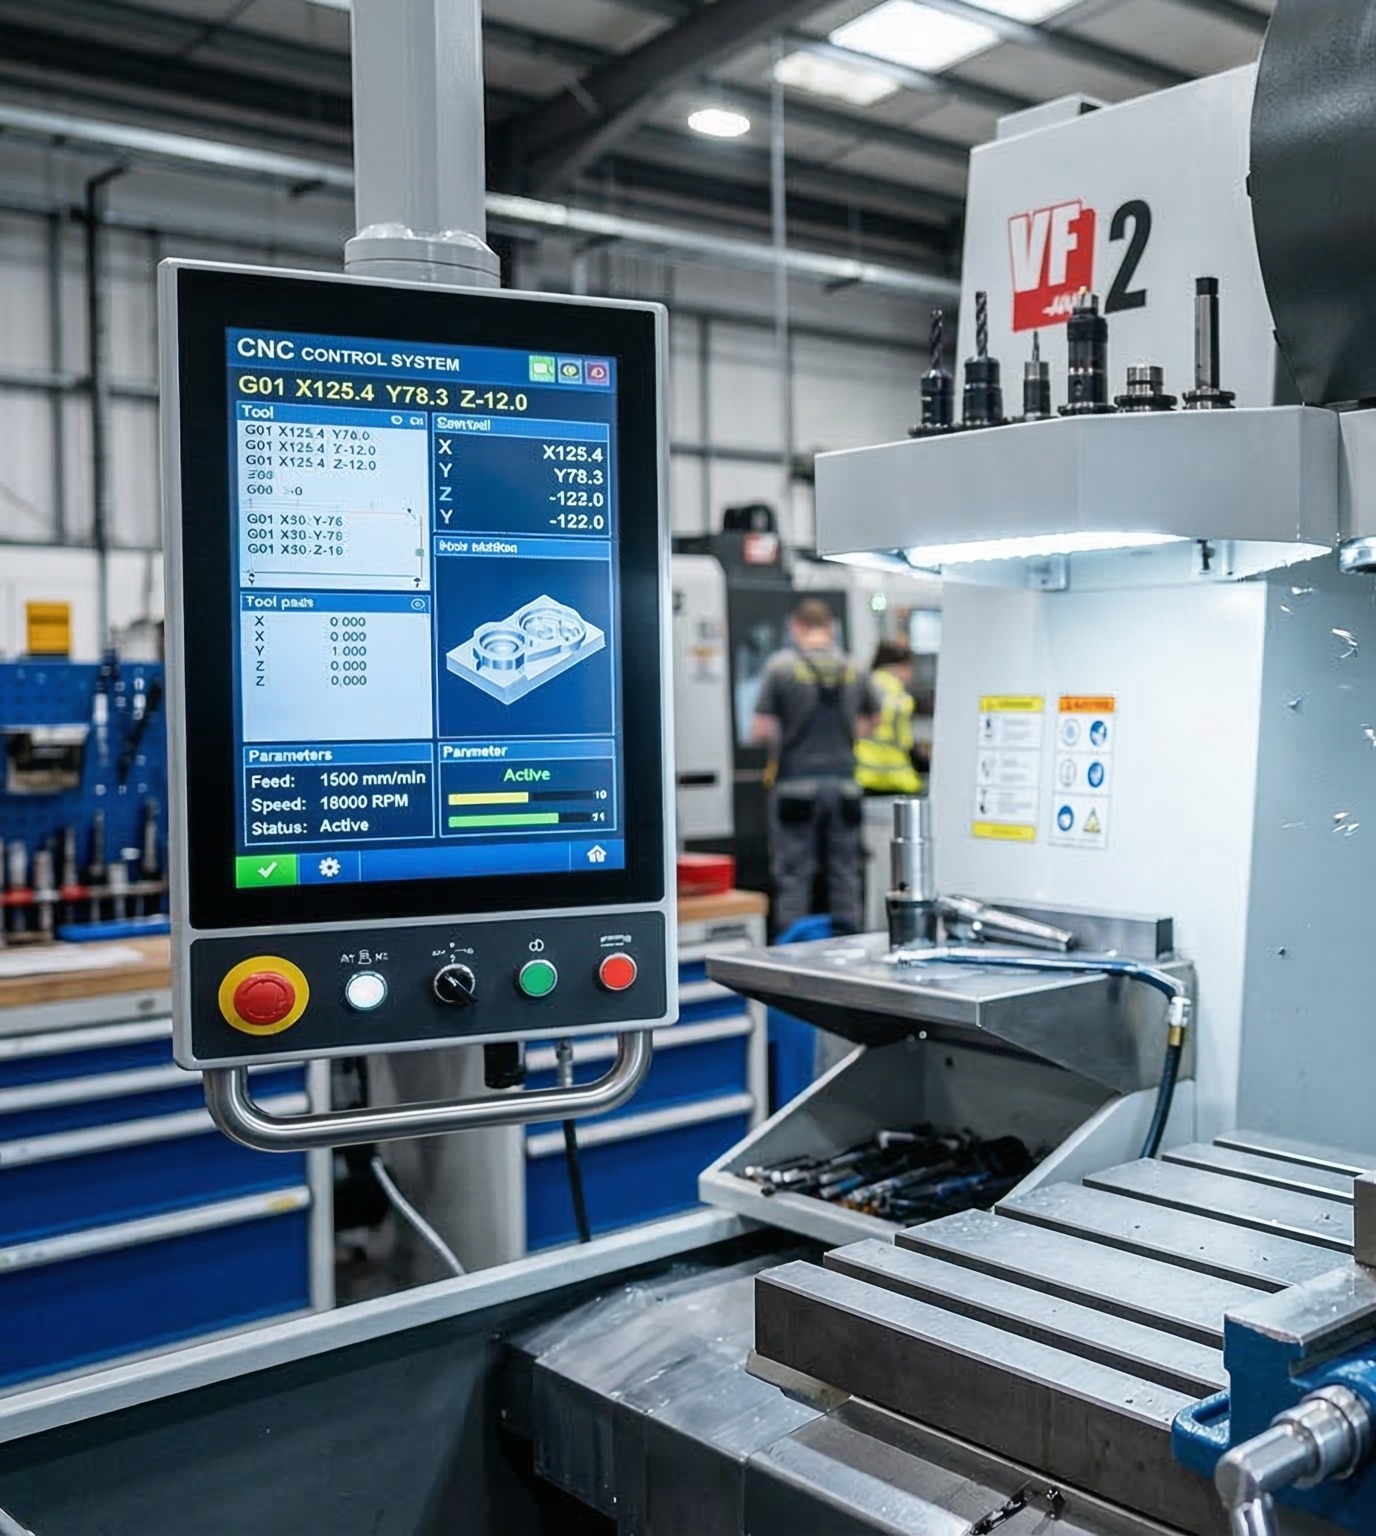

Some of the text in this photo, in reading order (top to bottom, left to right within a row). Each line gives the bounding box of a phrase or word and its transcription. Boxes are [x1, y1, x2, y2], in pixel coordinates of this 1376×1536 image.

[1009, 199, 1152, 314] VF 2
[237, 337, 460, 371] CNC CONTROL SYSTEM
[238, 375, 528, 411] G01 X125.4 Y78.3 Z-12.0
[242, 404, 274, 419] Tool
[245, 424, 272, 436] G01
[245, 440, 272, 451] G01
[438, 439, 604, 463] X X125.4
[246, 455, 272, 466] G01
[439, 462, 604, 485] Y Y78.3
[439, 486, 453, 501] Z
[439, 509, 453, 524] Y
[245, 595, 277, 608] Tool
[255, 615, 264, 626] X
[255, 630, 265, 641] X
[255, 645, 265, 657] Y
[256, 660, 265, 671] Z
[256, 675, 265, 686] Z
[249, 749, 333, 763] Parameters
[251, 770, 426, 788] Feed: 1500 mm/min
[503, 768, 551, 782] Active
[251, 794, 409, 815] Speed: 18000 RPM
[252, 818, 369, 836] Status: Active
